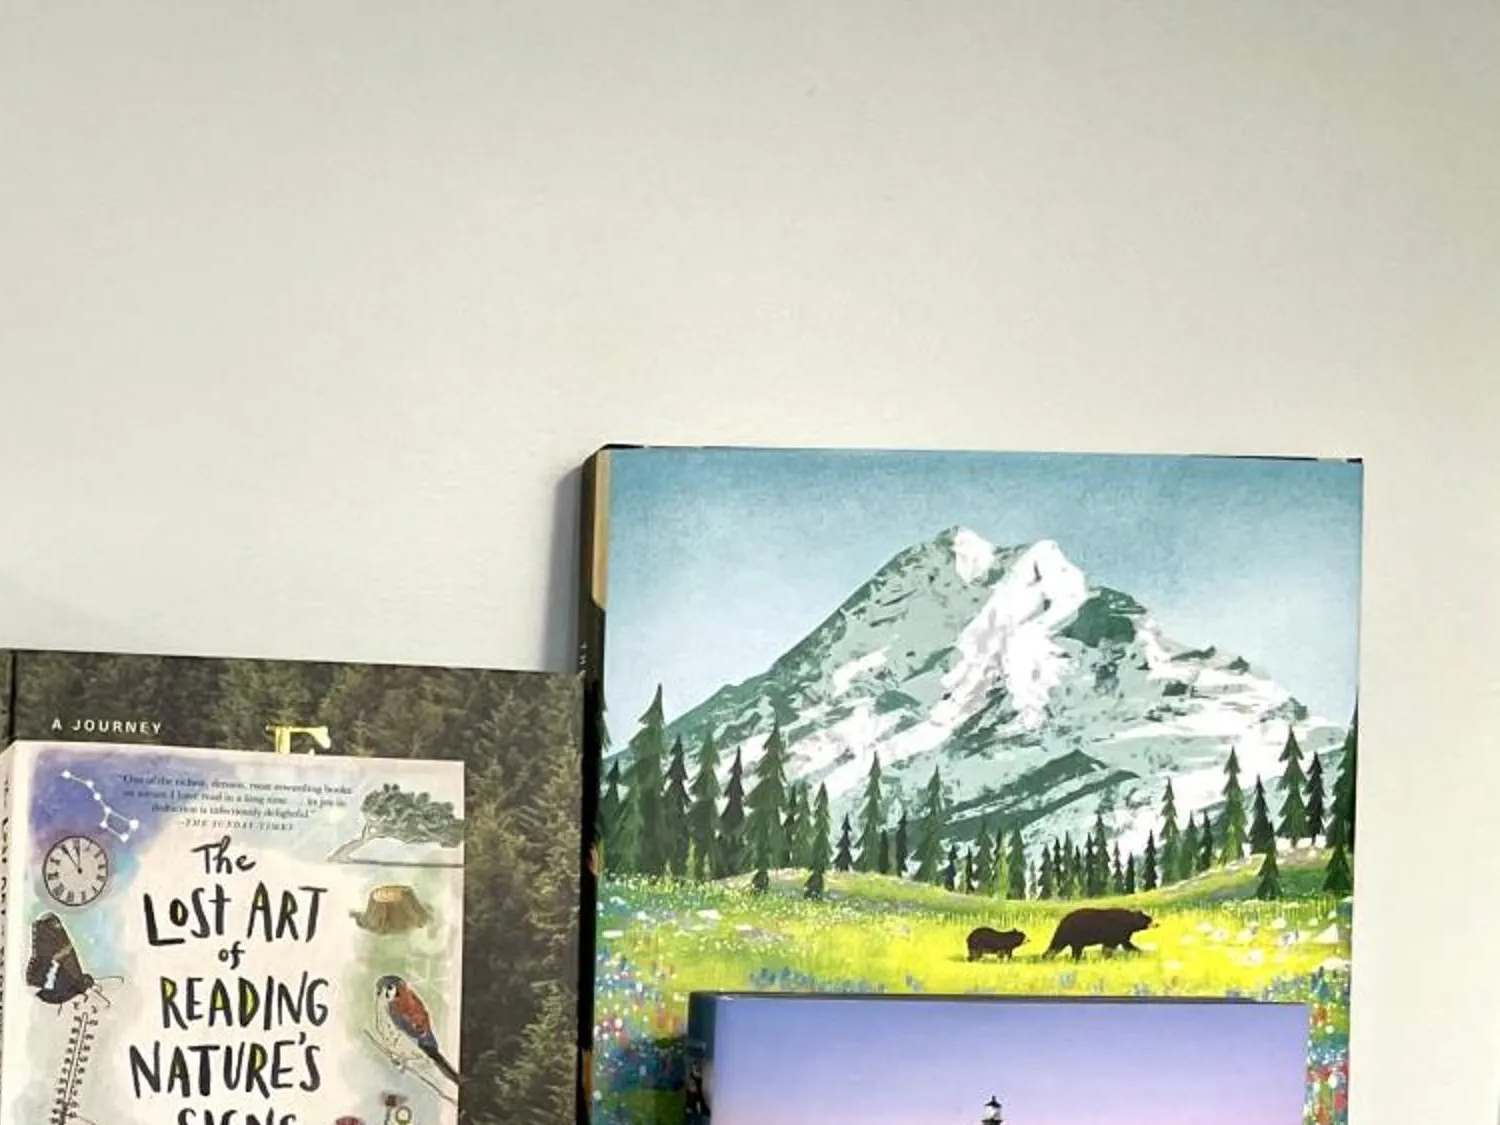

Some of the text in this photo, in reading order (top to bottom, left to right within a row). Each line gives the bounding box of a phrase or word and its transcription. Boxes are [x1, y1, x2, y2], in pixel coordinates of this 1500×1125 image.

[51, 719, 162, 735] A JOURNEY
[190, 835, 257, 875] The
[246, 880, 328, 943] ART
[218, 941, 245, 970] of
[160, 970, 329, 1031] READING
[129, 1031, 321, 1099] NATURE'S
